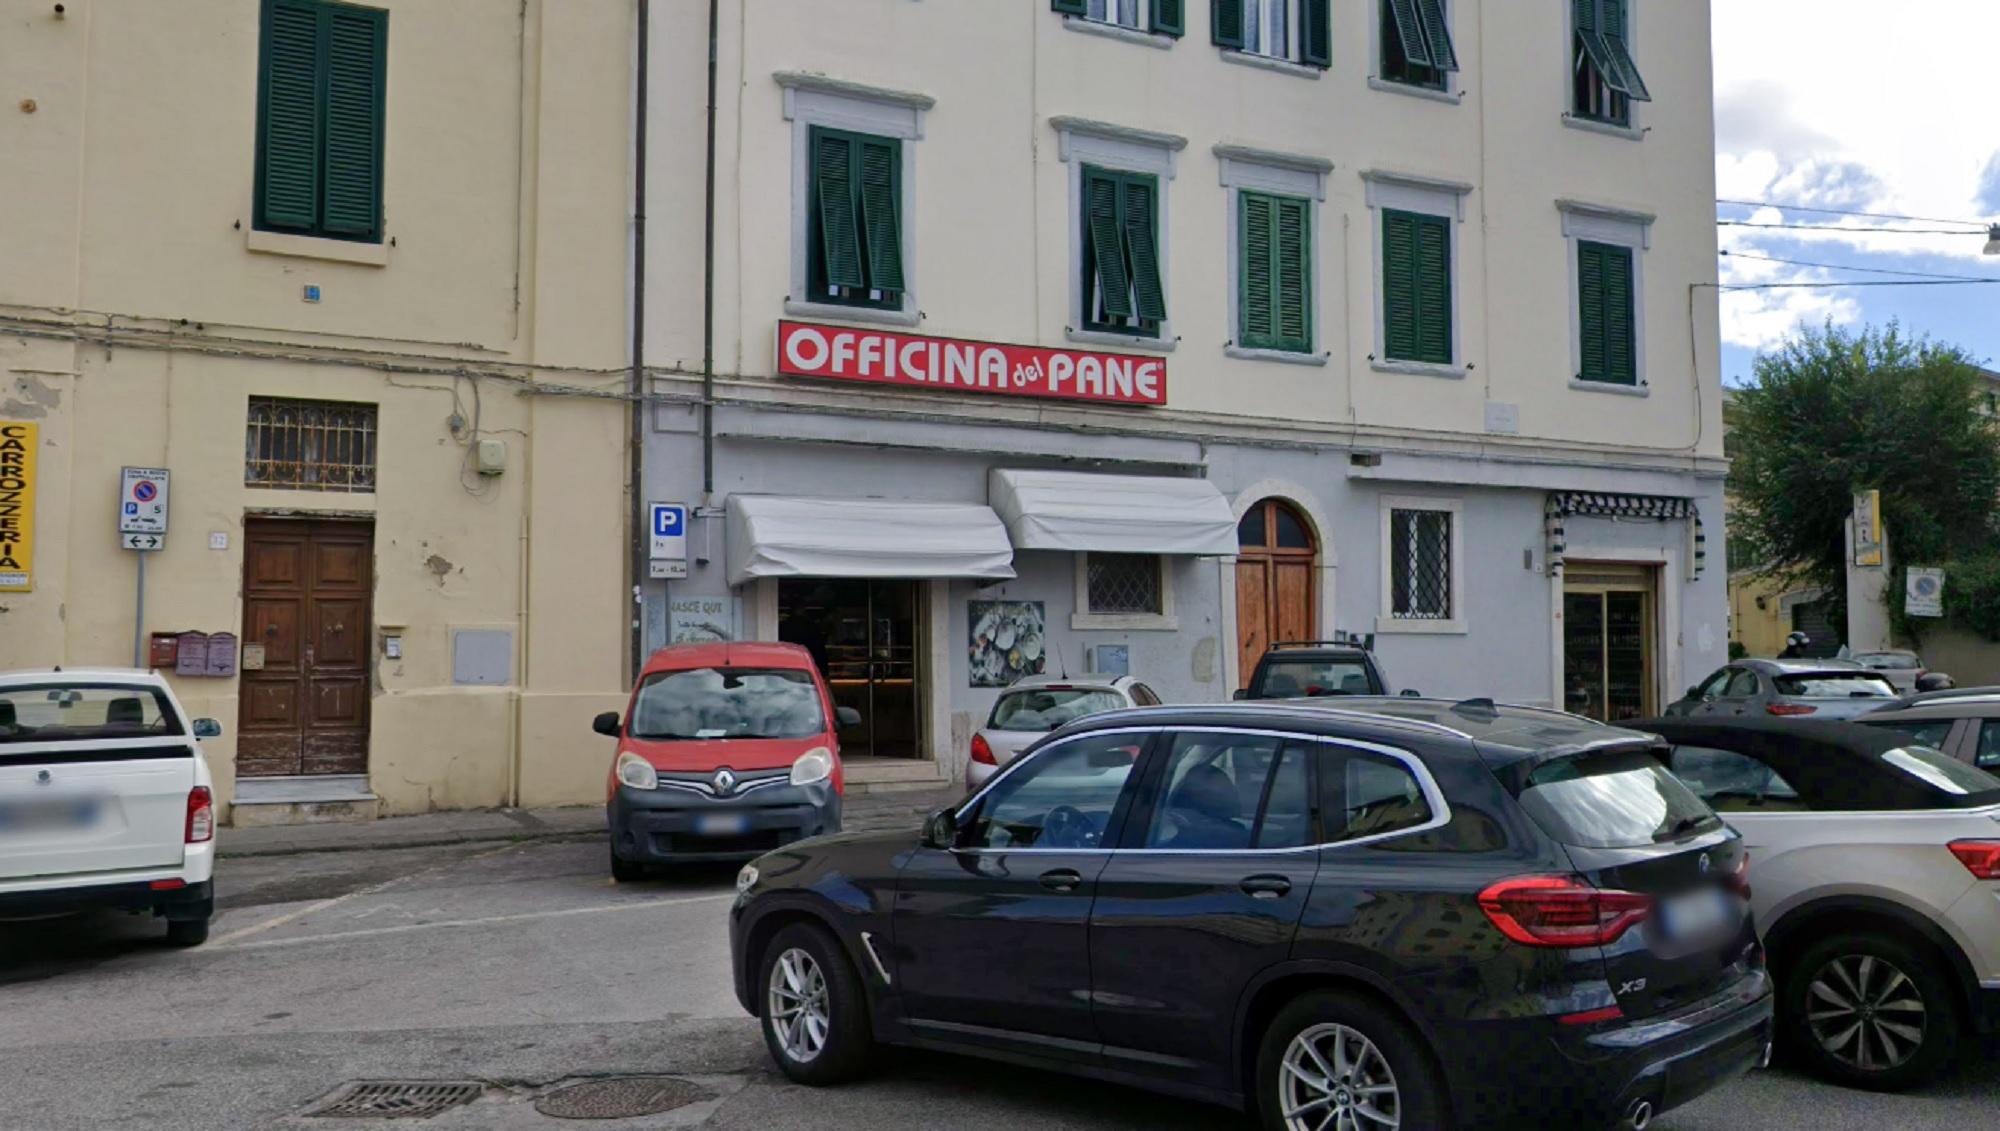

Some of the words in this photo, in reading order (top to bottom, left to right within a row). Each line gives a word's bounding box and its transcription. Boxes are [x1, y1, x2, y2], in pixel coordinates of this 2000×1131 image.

[785, 327, 1008, 388] OFFICINA
[1013, 356, 1044, 387] del
[1048, 353, 1158, 399] PANE
[0, 426, 26, 569] CARROZZERIA
[660, 511, 677, 532] P
[1617, 977, 1647, 995] X3
